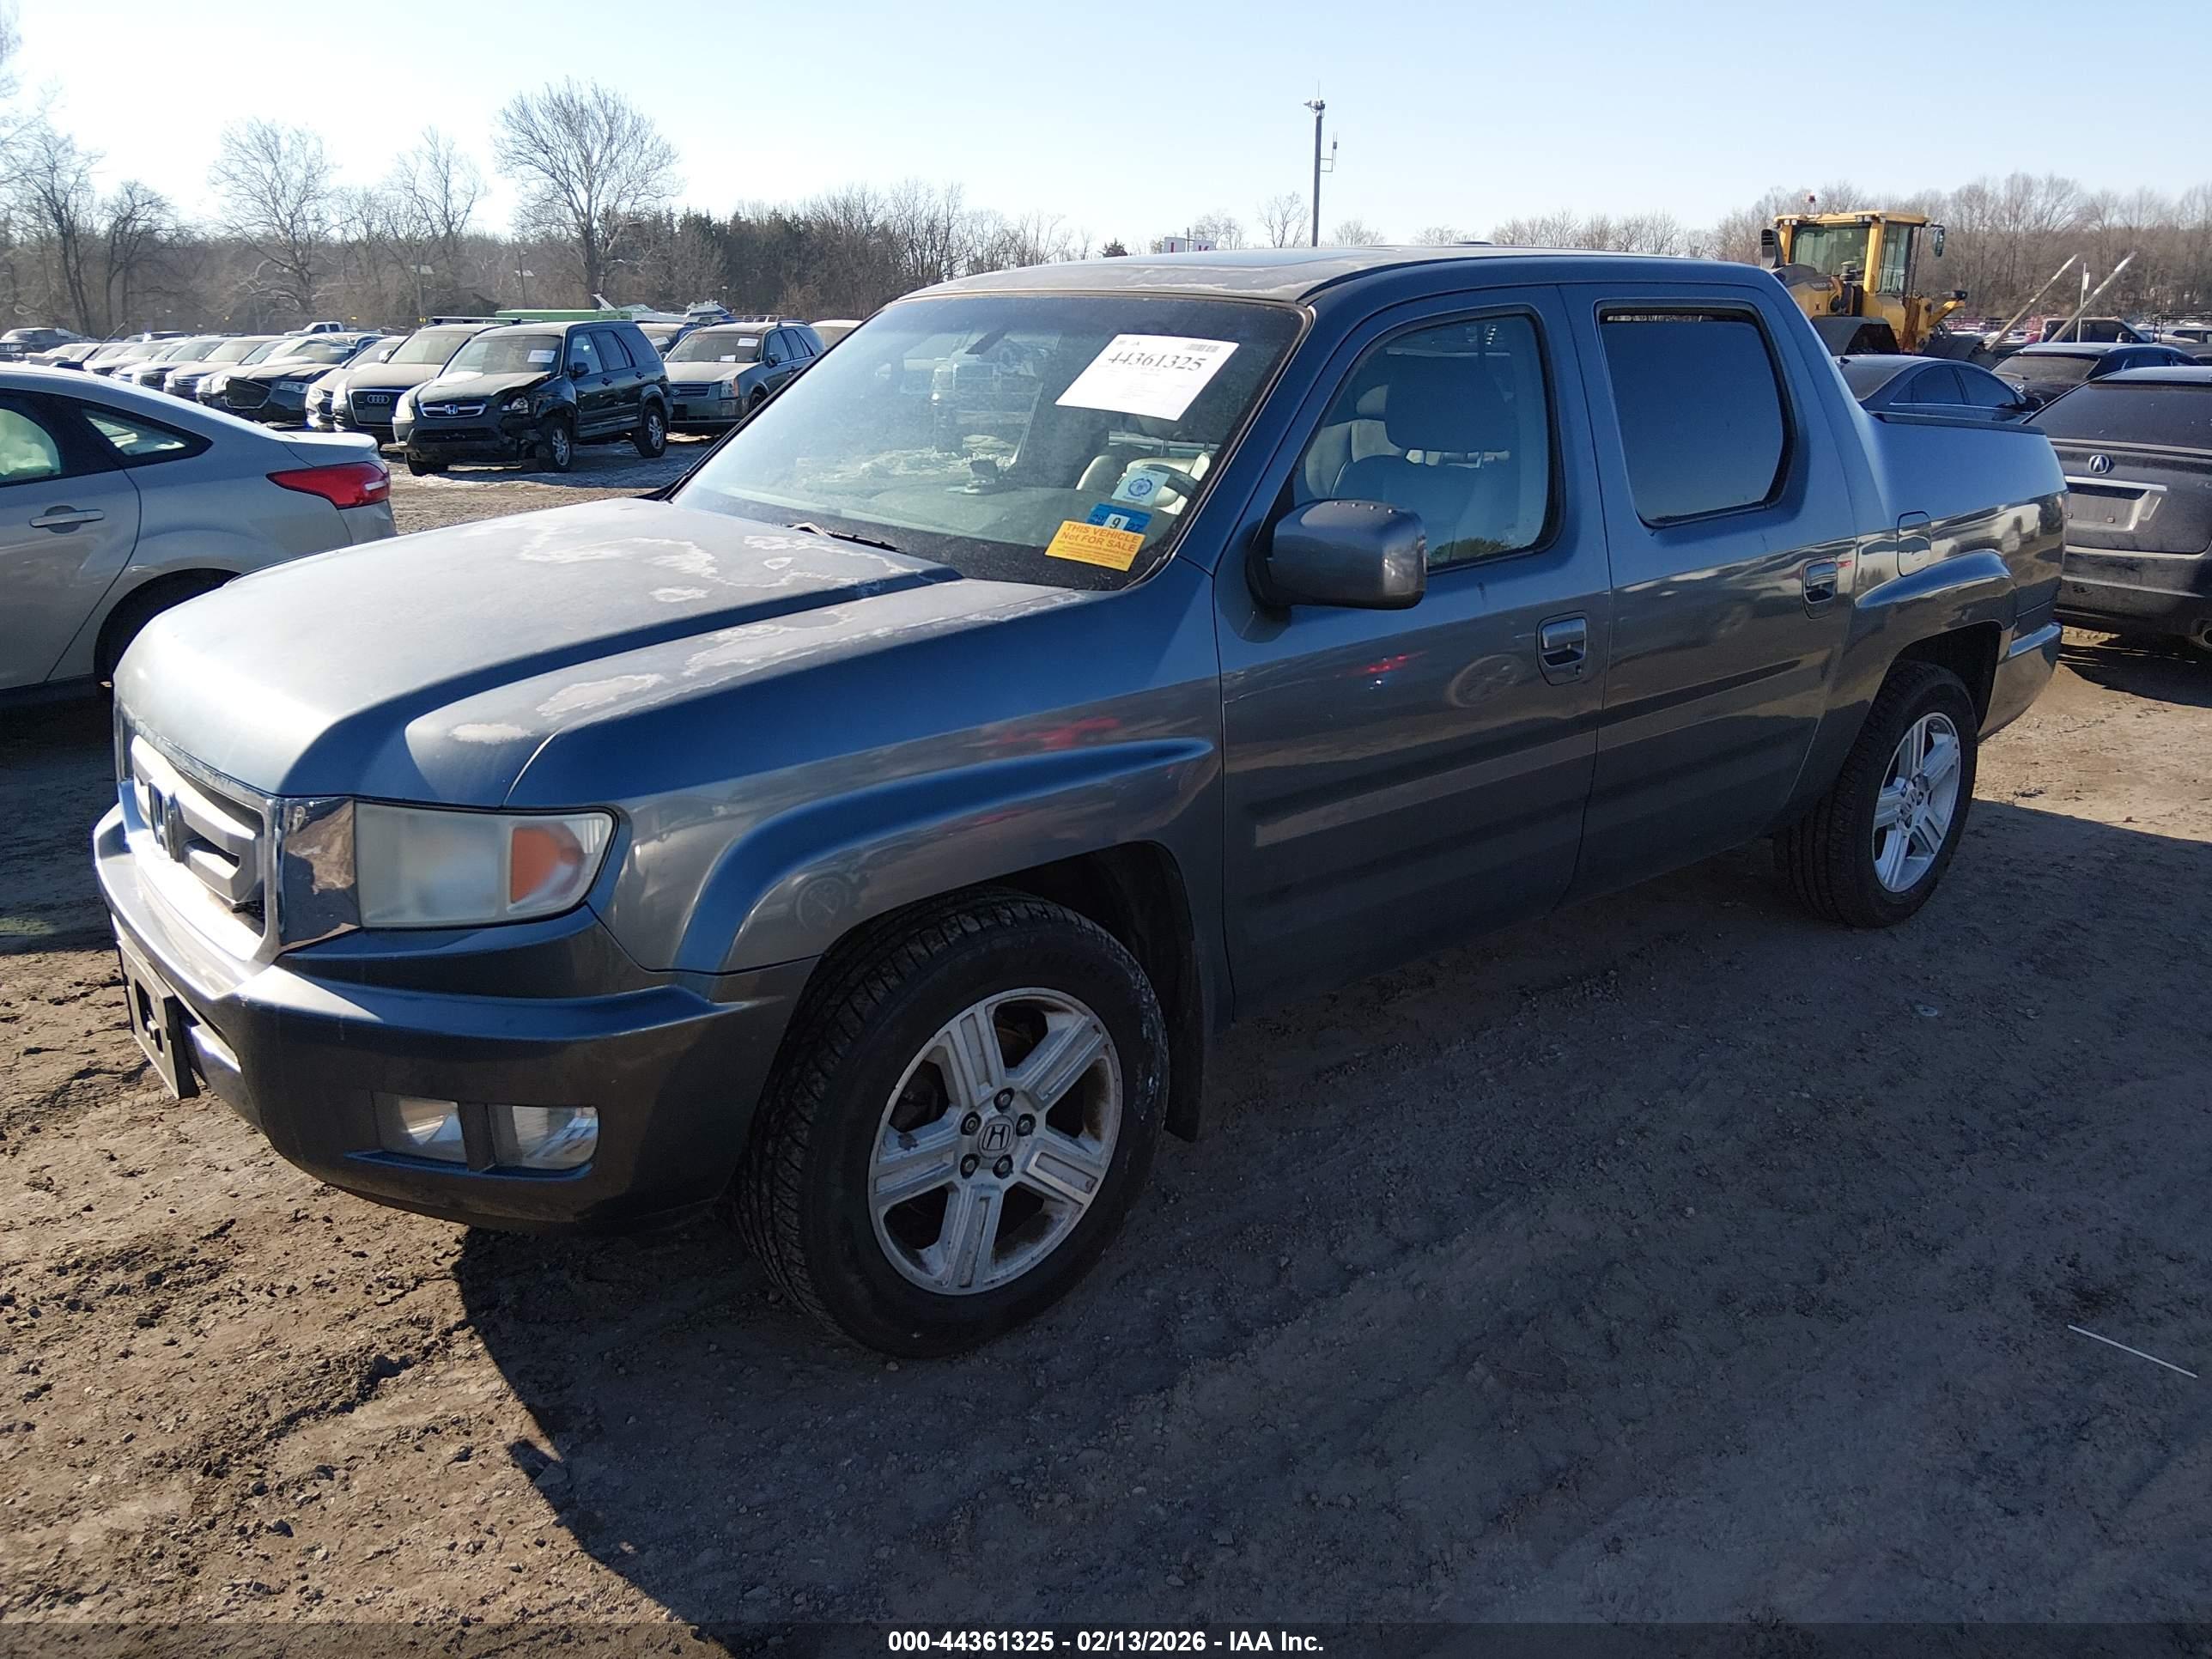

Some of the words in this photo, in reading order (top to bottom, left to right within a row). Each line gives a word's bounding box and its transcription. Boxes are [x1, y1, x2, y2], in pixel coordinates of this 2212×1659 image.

[1107, 350, 1208, 372] 44361325
[1109, 517, 1121, 529] 9
[1060, 532, 1079, 541] Not
[1080, 534, 1105, 545] FOR
[1106, 538, 1138, 552] SALE
[1066, 523, 1091, 534] THIS
[1093, 526, 1140, 544] VEHICLE
